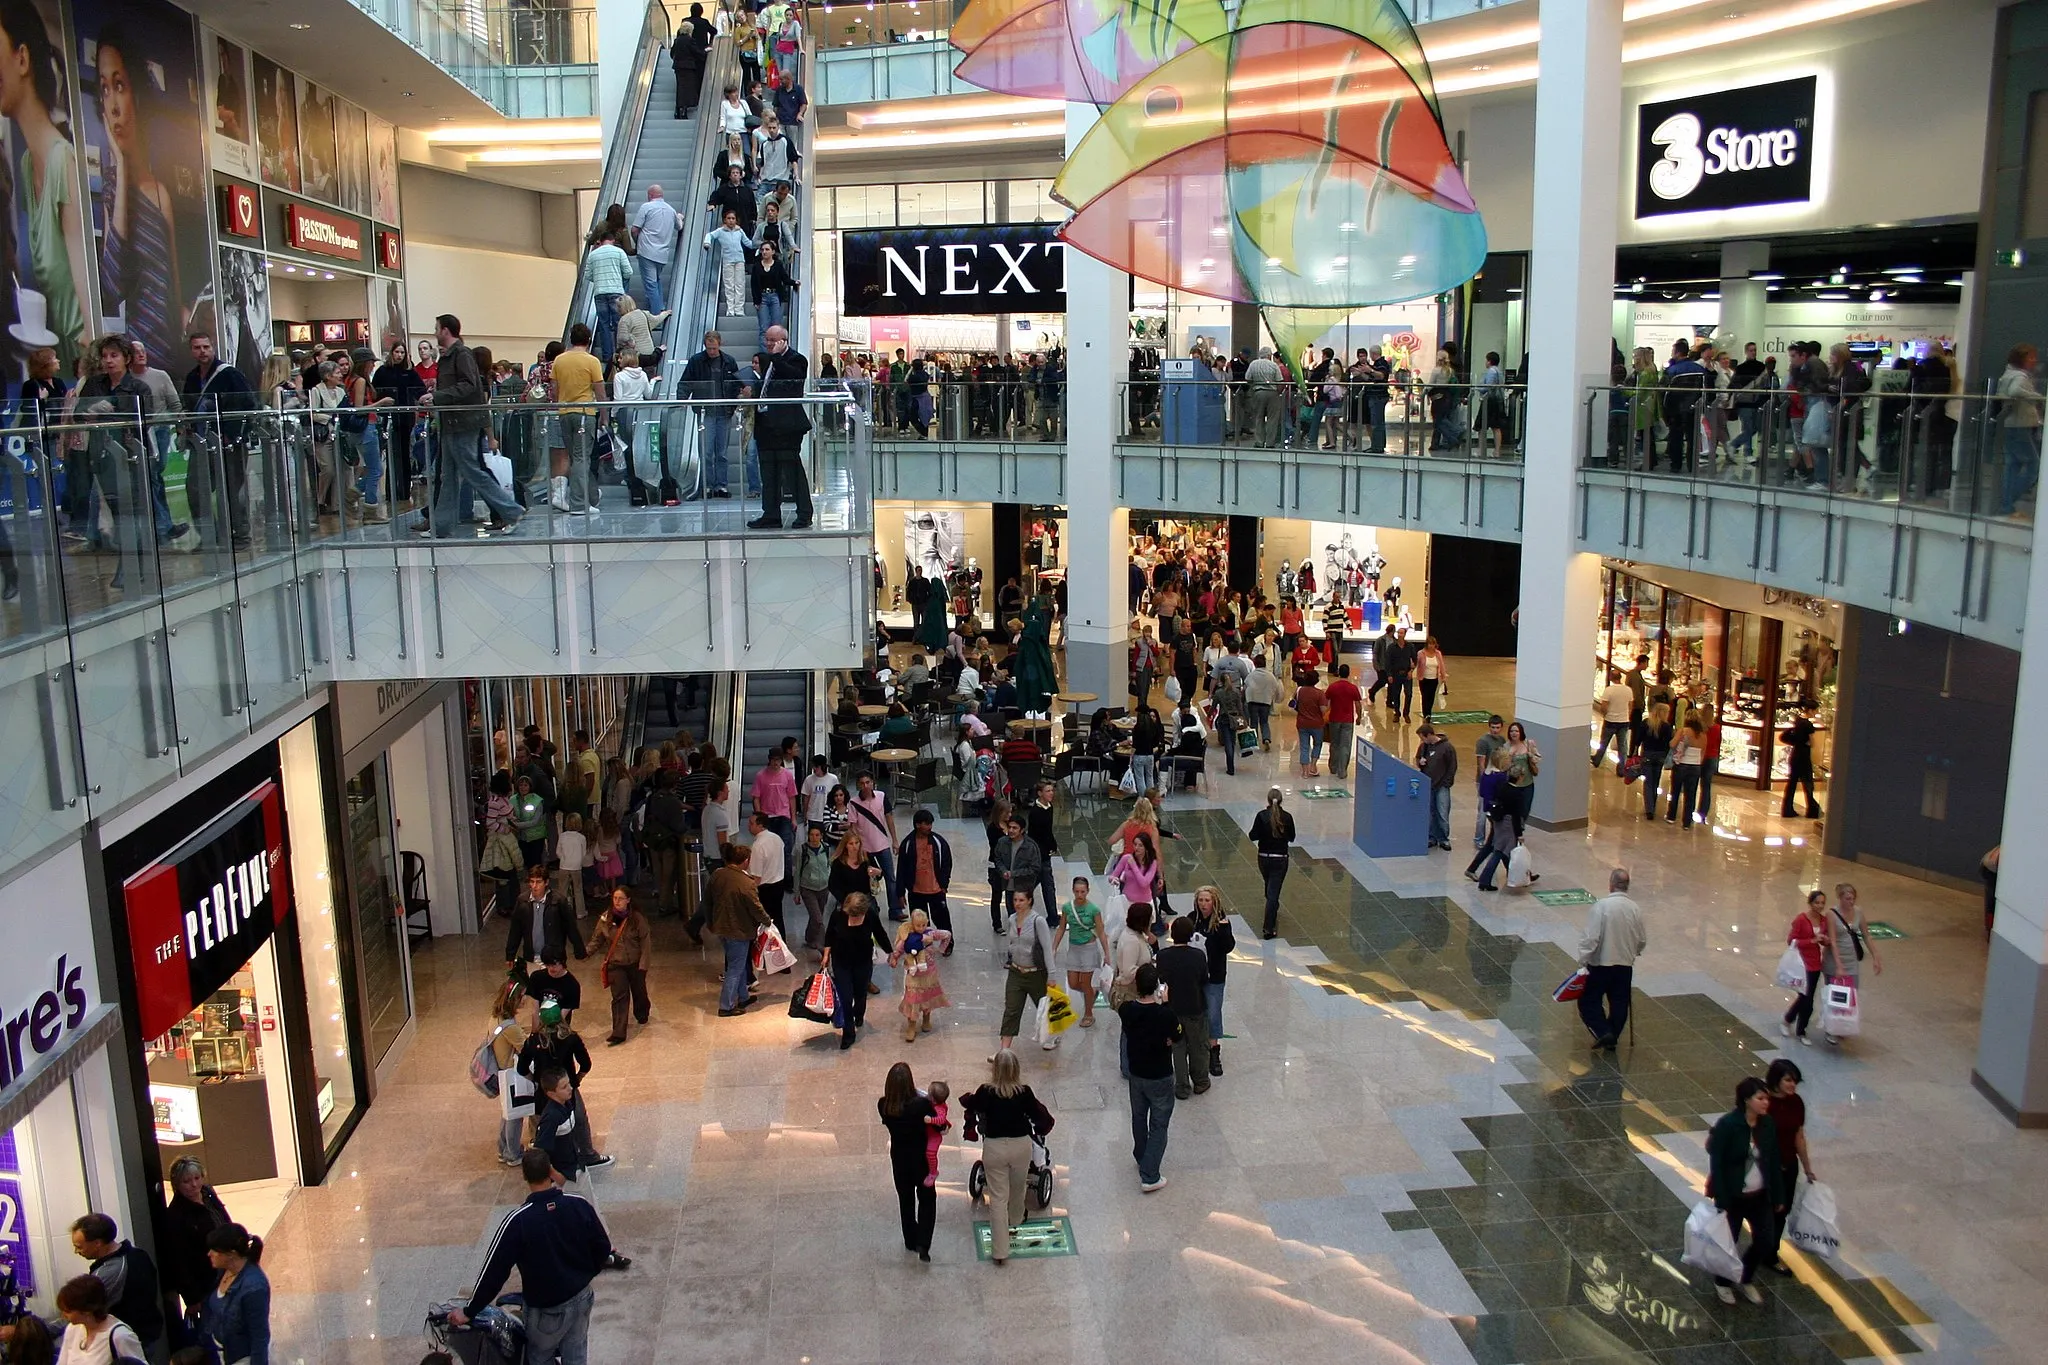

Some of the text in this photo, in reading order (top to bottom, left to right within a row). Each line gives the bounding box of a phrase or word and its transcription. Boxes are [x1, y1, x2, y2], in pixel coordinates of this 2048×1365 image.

[1650, 112, 1704, 200] 3
[1705, 127, 1797, 175] Store
[1634, 311, 1662, 321] obiles
[1845, 312, 1858, 322] On
[1859, 313, 1873, 321] air
[155, 849, 270, 964] THE PERFUME
